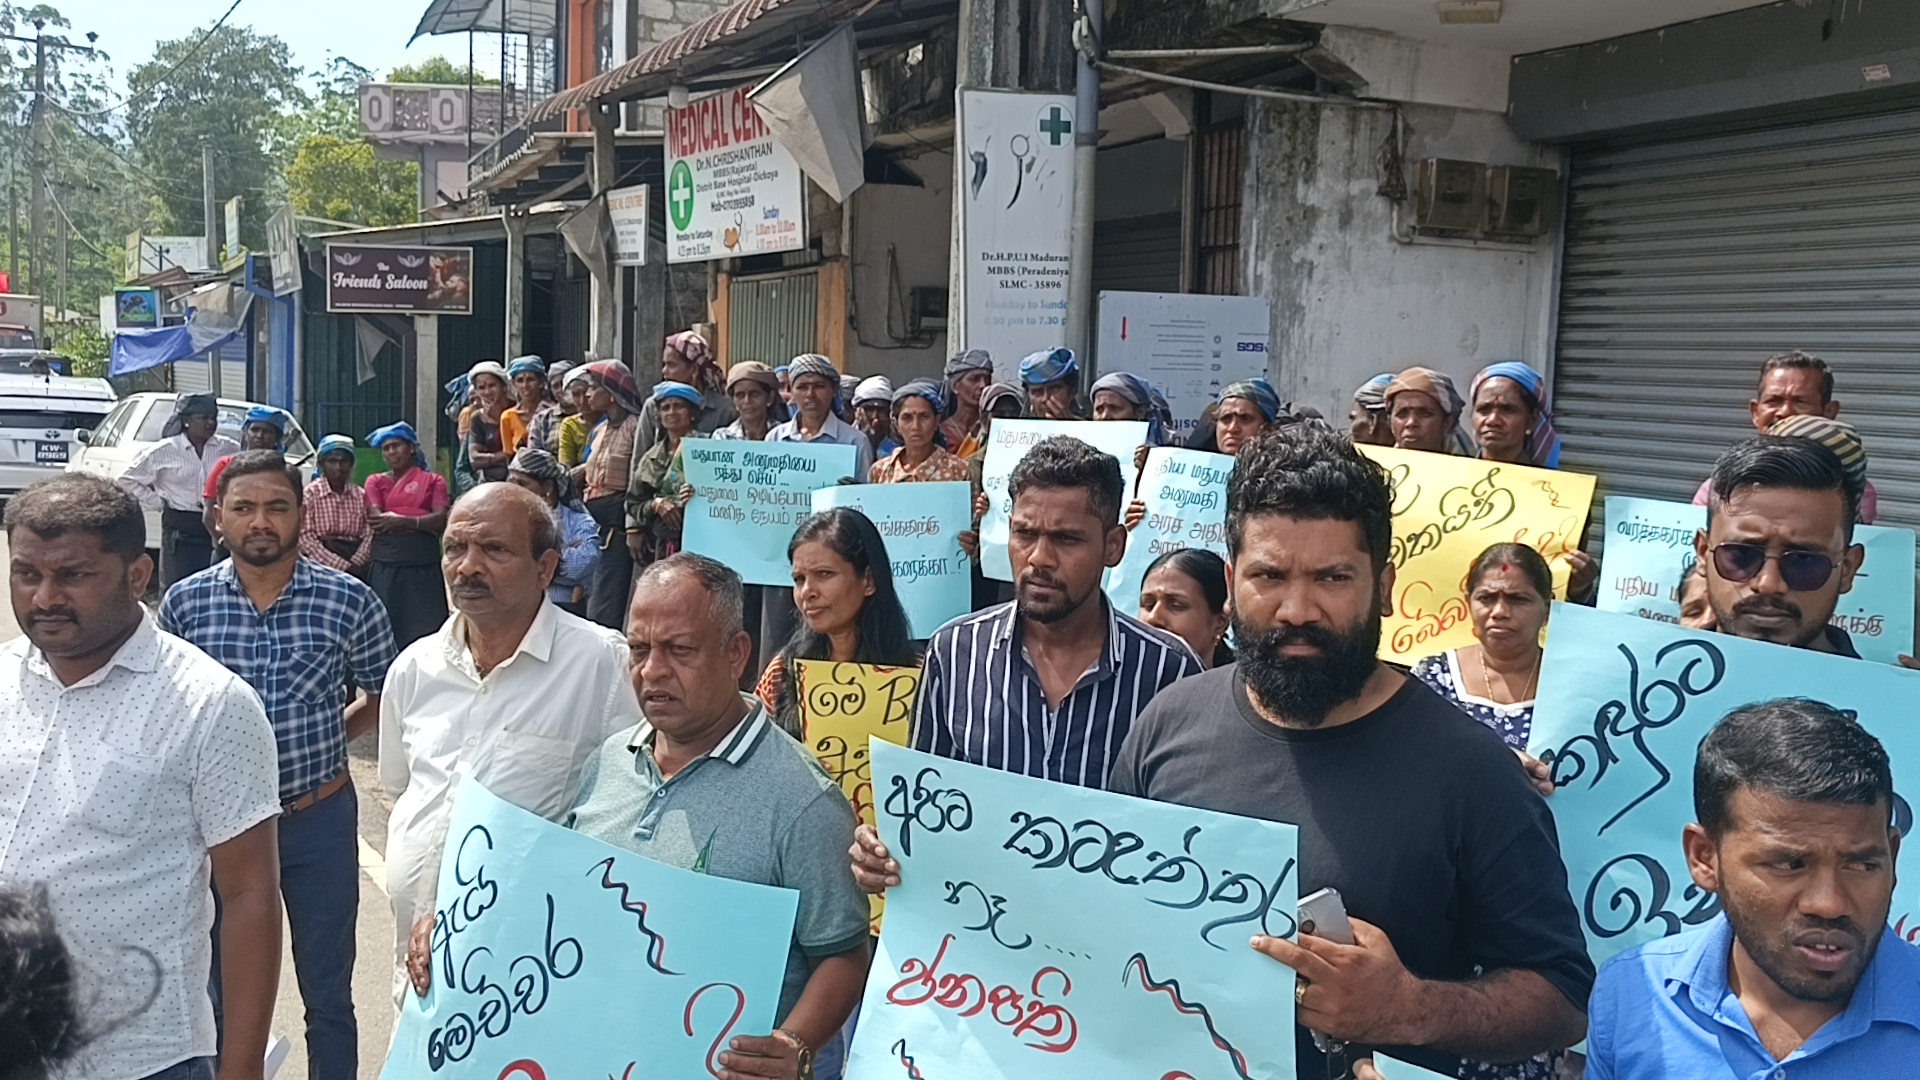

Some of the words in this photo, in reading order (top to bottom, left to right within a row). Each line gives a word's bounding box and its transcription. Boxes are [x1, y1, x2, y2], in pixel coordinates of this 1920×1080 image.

[669, 95, 729, 160] MEDICAL
[732, 84, 772, 144] CEN
[696, 141, 773, 171] Dr.N.CHRISHANTHAN
[714, 179, 727, 190] Base
[763, 205, 780, 221] Sunday
[676, 232, 690, 243] Monday
[696, 230, 713, 241] Saturday
[982, 252, 1028, 262] Dr.H.P.U.I
[1030, 253, 1070, 262] Maduran
[987, 266, 1016, 275] MBBS
[333, 272, 381, 290] Friends
[385, 274, 428, 290] Saloon
[1000, 280, 1027, 289] SLMC
[1034, 281, 1062, 289] 35896
[1028, 301, 1038, 309] to
[1008, 318, 1023, 327] pm
[1027, 317, 1036, 325] to
[1039, 317, 1059, 325] 7.30
[691, 449, 735, 464] மதுபான
[1160, 485, 1218, 513] அனுமதி
[709, 504, 746, 525] மனித
[1148, 513, 1184, 535] அரச
[1617, 515, 1694, 549] வர்த்தகர்க
[1615, 575, 1659, 600] புதிய
[884, 767, 973, 858] අපිට
